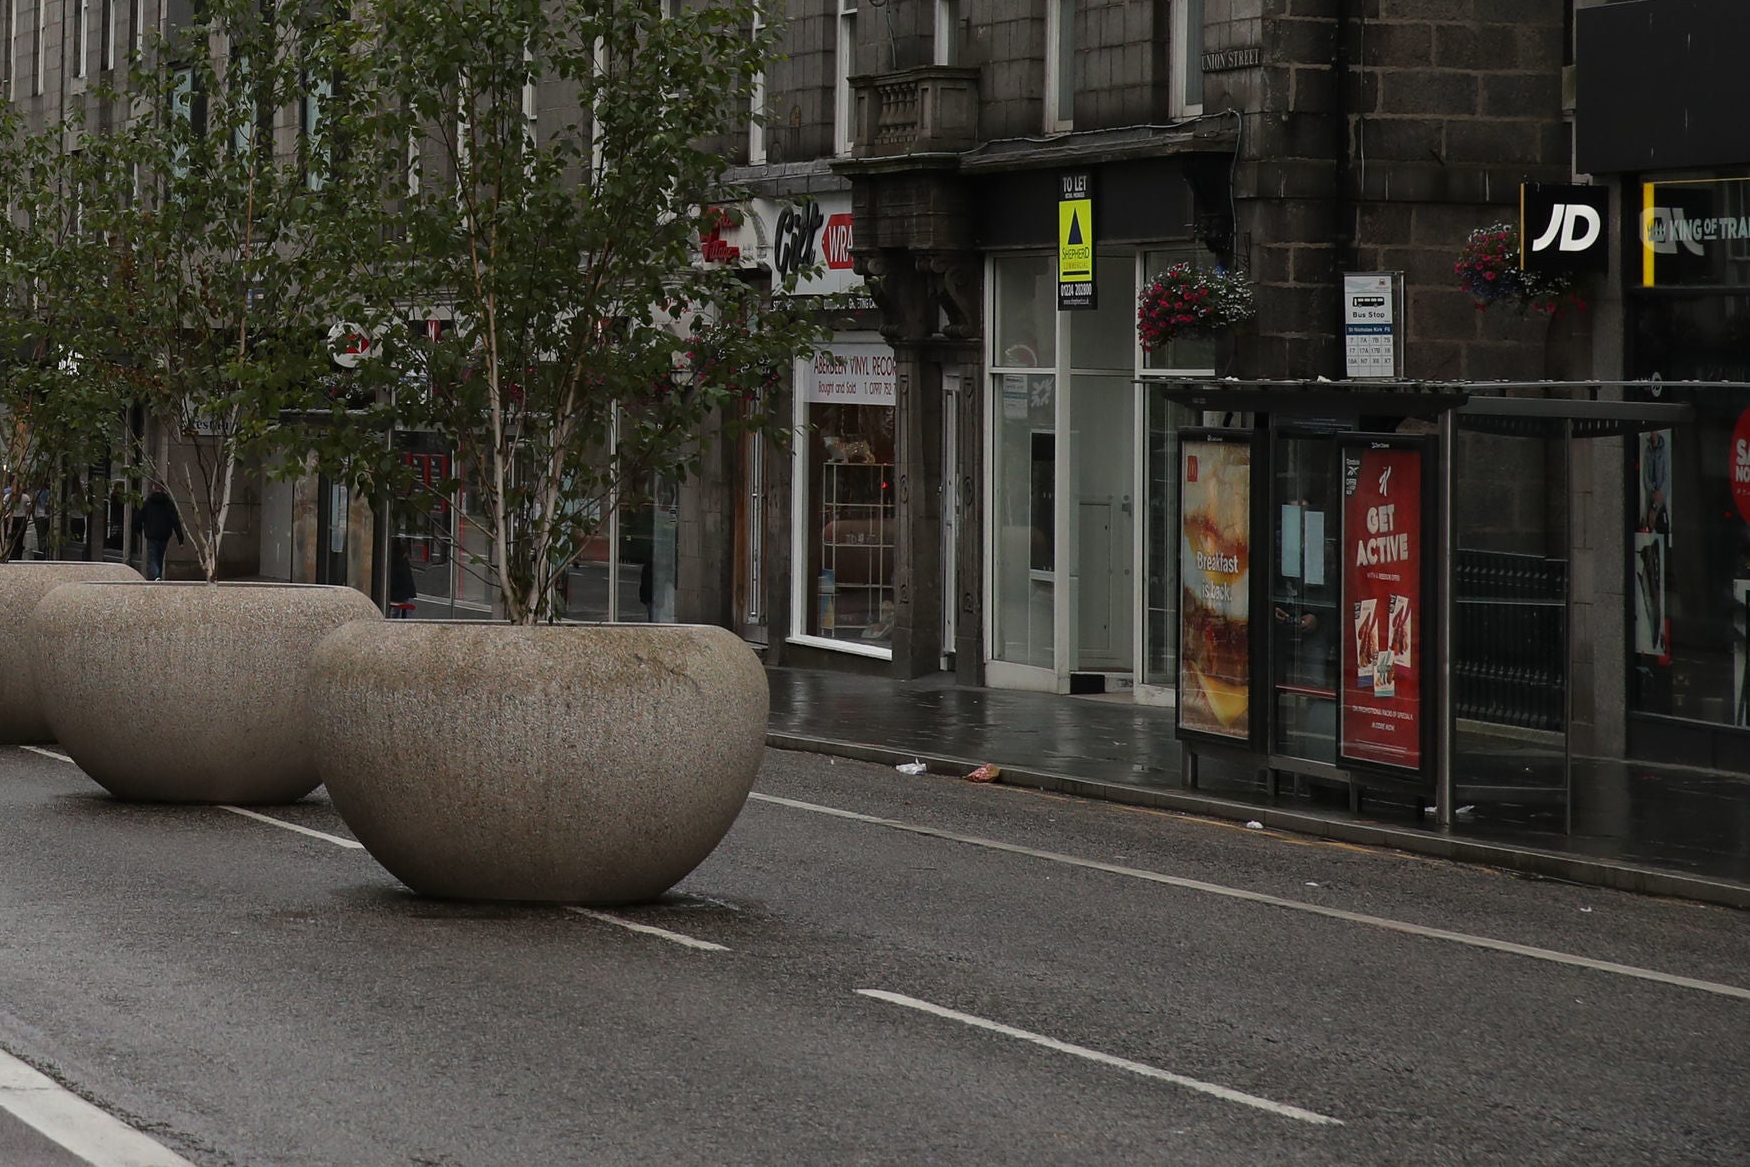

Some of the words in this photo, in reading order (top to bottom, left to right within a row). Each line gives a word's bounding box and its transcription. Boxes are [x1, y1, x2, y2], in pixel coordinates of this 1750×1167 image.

[1063, 176, 1072, 192] TO
[1075, 176, 1087, 191] LET
[1532, 204, 1601, 252] JD
[1670, 218, 1703, 242] KING
[1704, 218, 1718, 234] OF
[775, 200, 824, 283] Gift
[1062, 247, 1090, 260] SHEPHERD
[1366, 504, 1395, 535] GET
[1197, 551, 1239, 573] Breakfast
[1356, 533, 1409, 567] ACTIVE
[1202, 579, 1209, 597] is
[1210, 581, 1233, 601] back.
